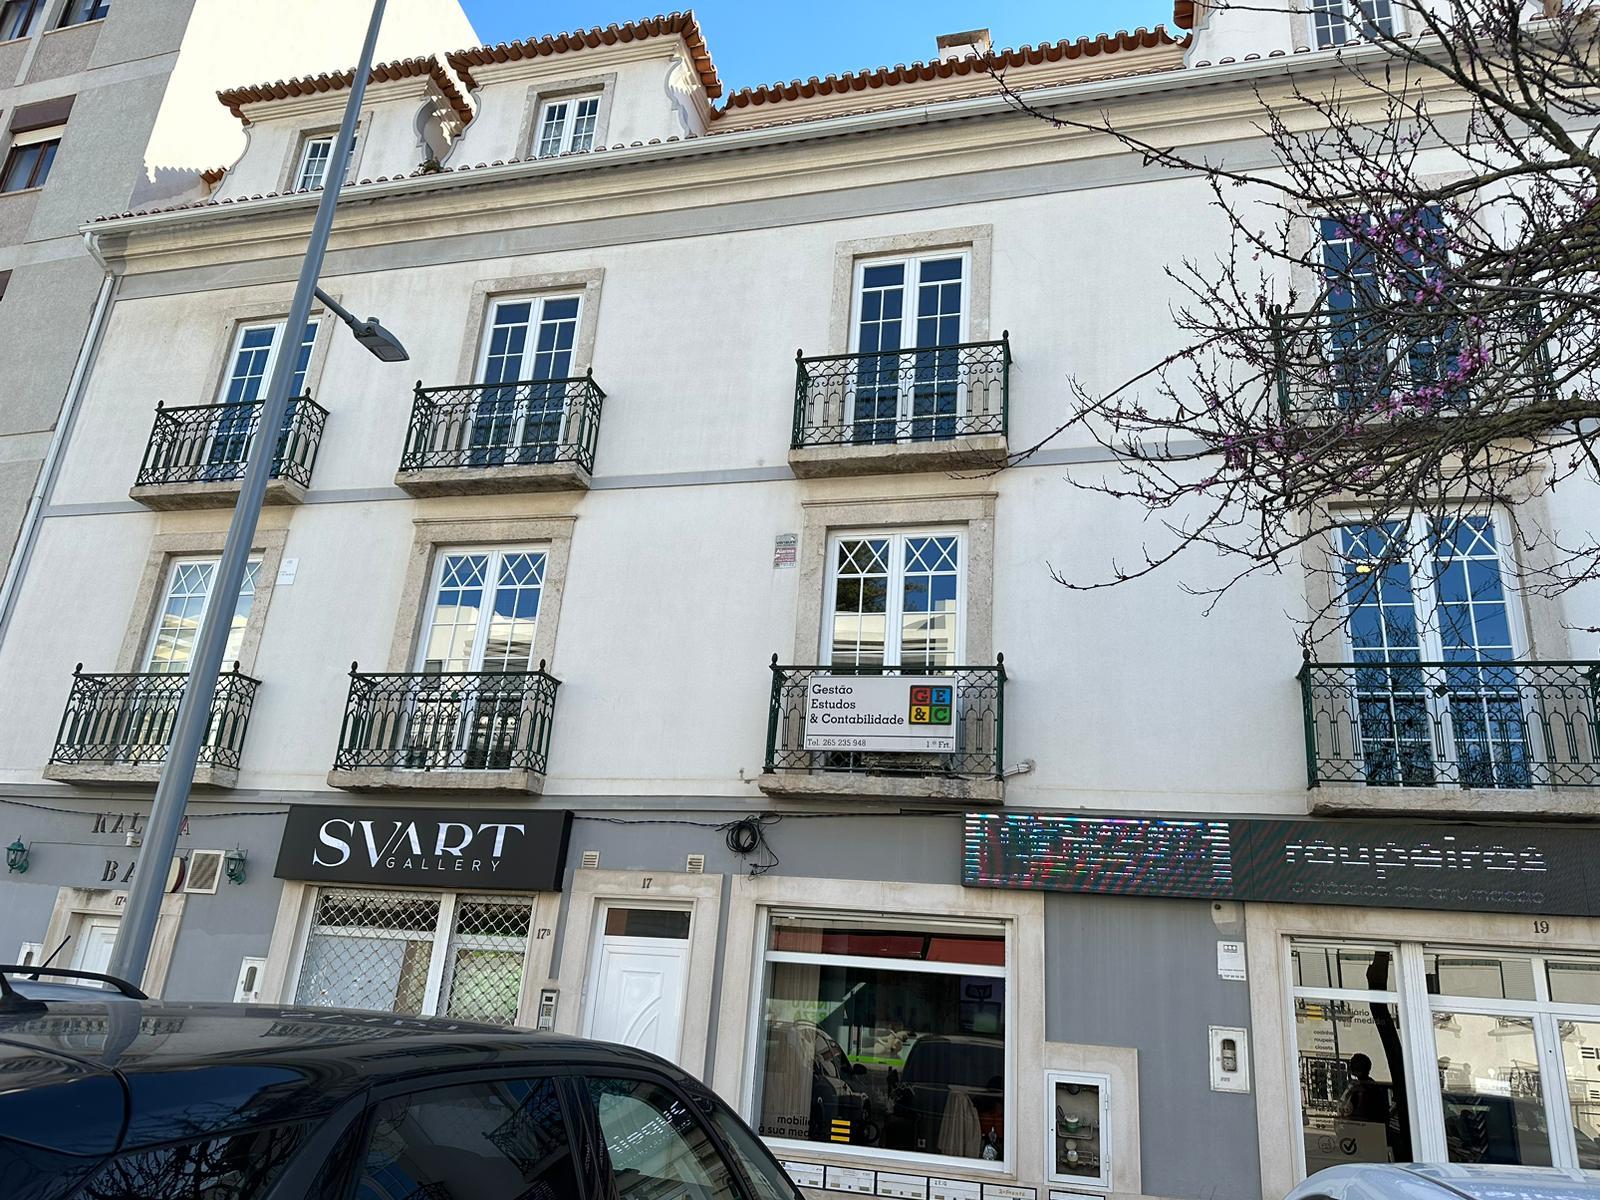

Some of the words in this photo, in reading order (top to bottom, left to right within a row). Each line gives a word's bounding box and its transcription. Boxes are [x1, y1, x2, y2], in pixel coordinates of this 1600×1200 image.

[812, 684, 853, 695] Gestão
[810, 699, 856, 710] Estudos
[809, 714, 819, 724] &
[821, 713, 905, 725] Contabilidade
[822, 739, 836, 747] 265
[837, 739, 851, 747] 235
[852, 739, 867, 747] 948
[312, 818, 526, 868] SVART
[385, 856, 501, 872] GALLERY
[641, 878, 653, 889] 17
[1533, 920, 1549, 934] 19
[767, 1126, 786, 1135] sua
